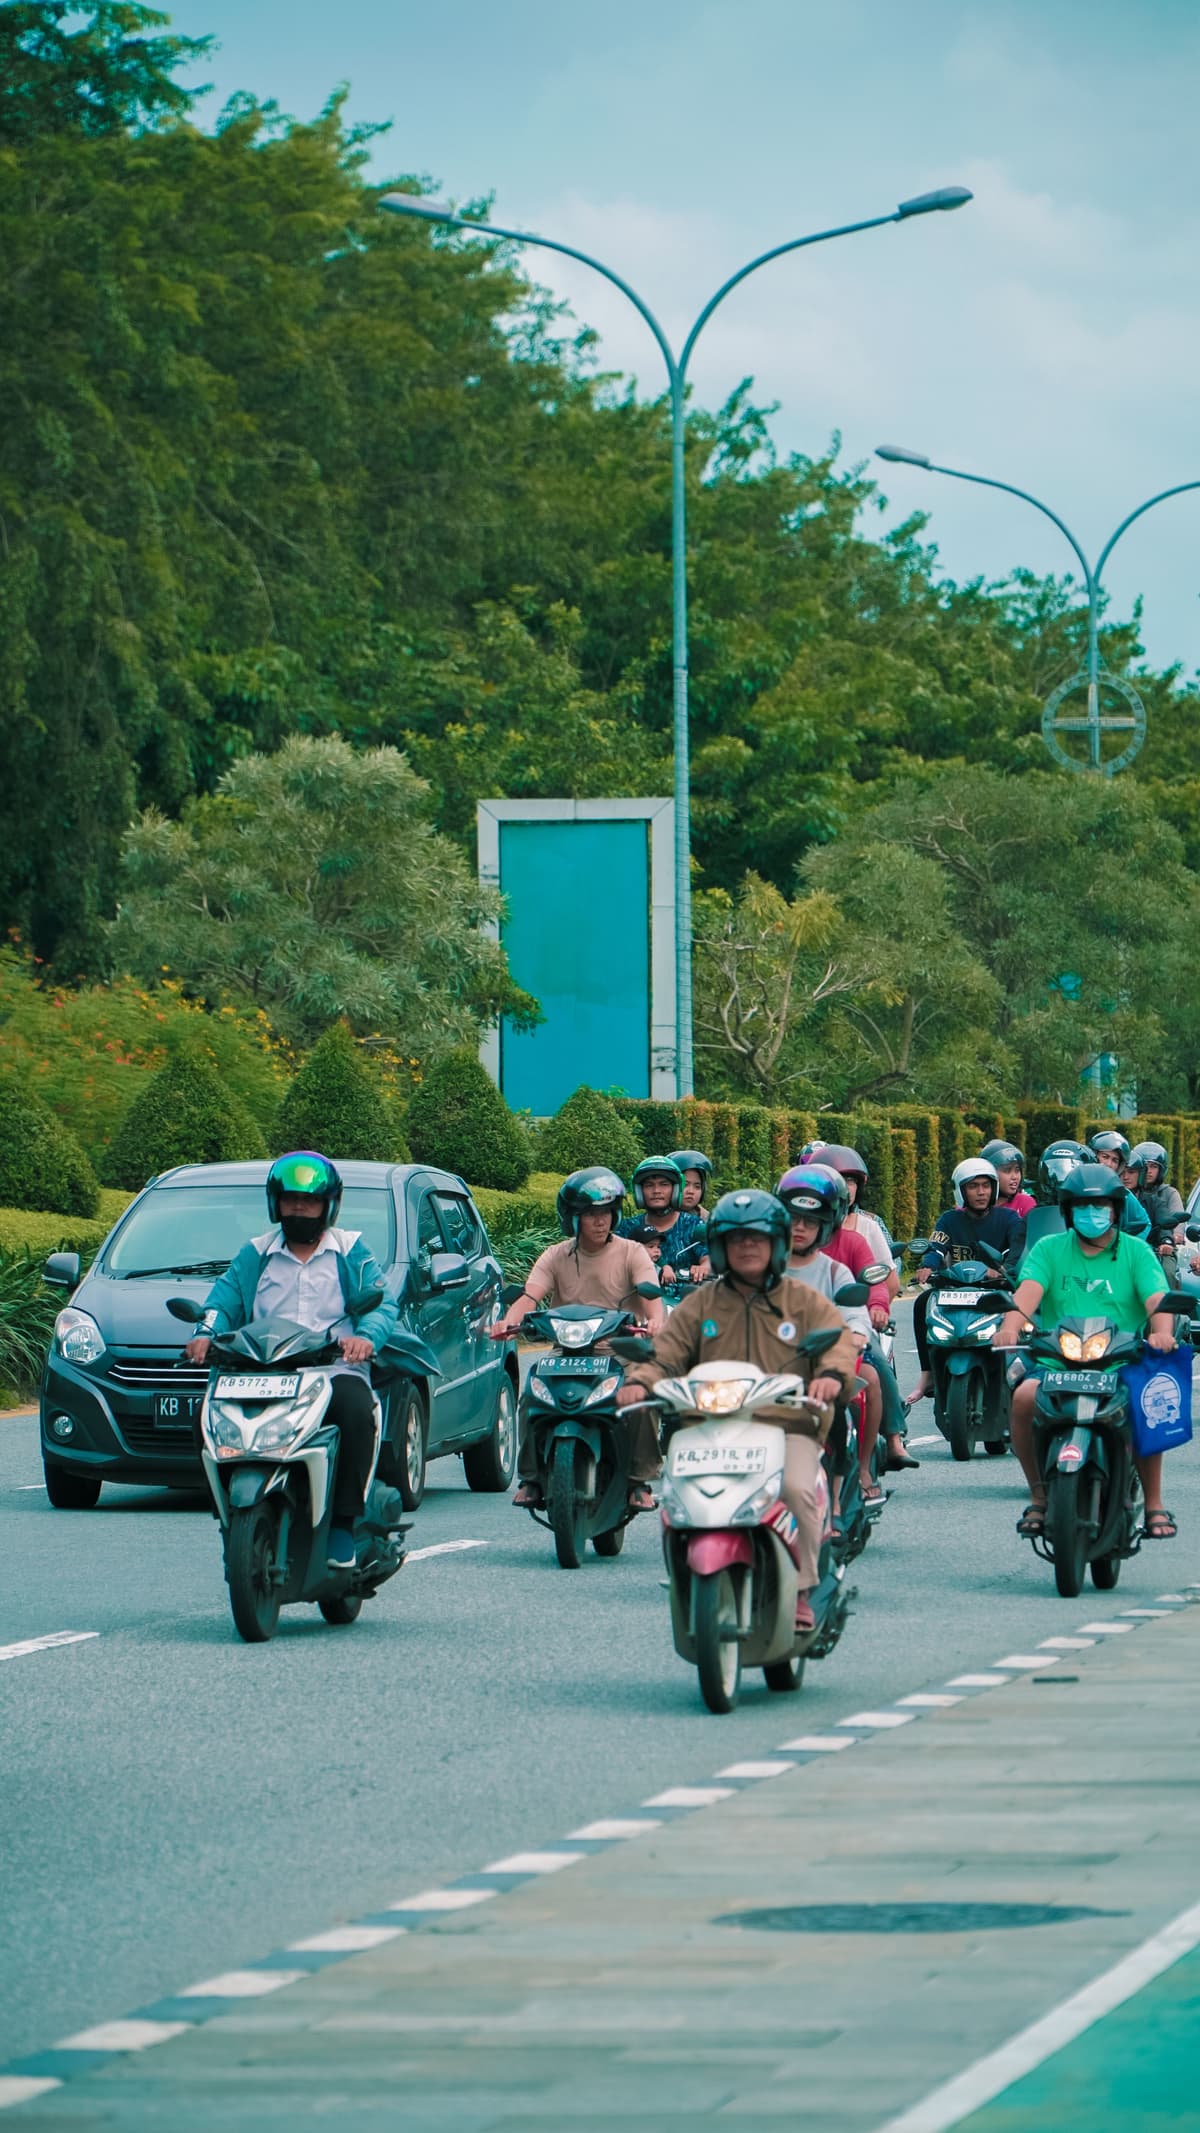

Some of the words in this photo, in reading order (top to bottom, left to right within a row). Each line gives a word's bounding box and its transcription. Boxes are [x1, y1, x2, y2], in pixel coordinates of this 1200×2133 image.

[540, 1358, 556, 1367] KB
[560, 1358, 587, 1367] 2124
[219, 1378, 235, 1387] KB
[238, 1378, 269, 1387] 5772
[280, 1377, 296, 1386] BK
[1047, 1373, 1063, 1382] KB
[1063, 1373, 1091, 1382] 6804
[160, 1397, 179, 1416] KB
[187, 1397, 202, 1416] 1
[677, 1450, 697, 1462] KB
